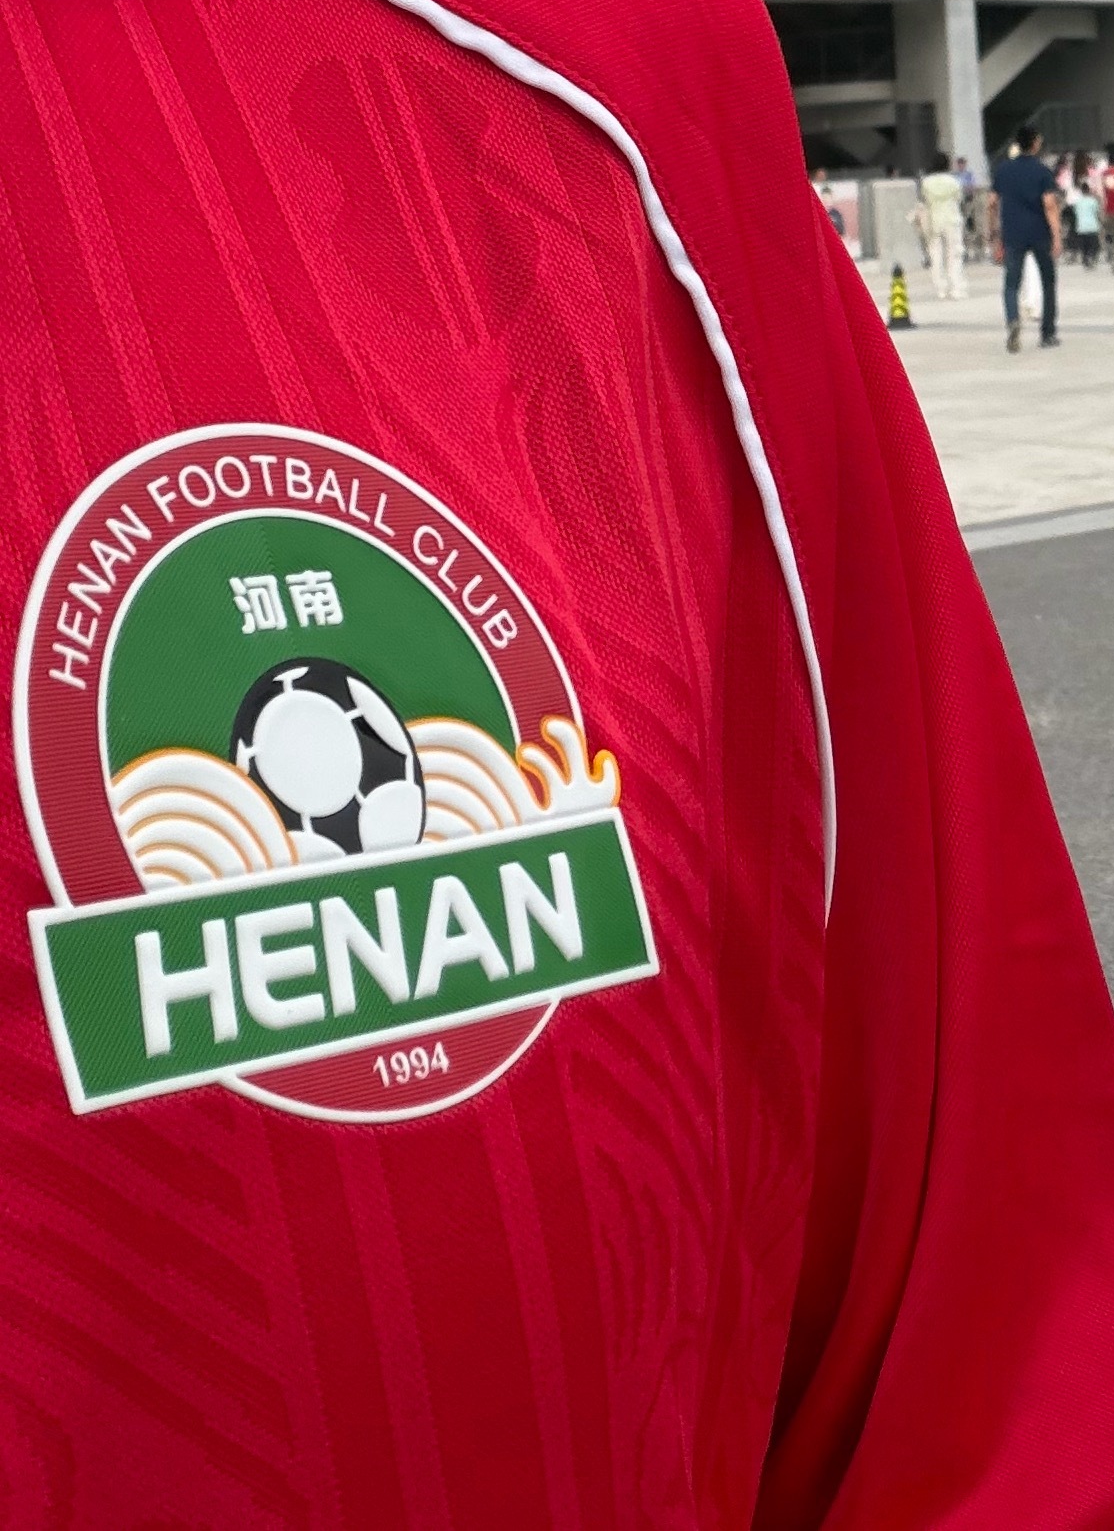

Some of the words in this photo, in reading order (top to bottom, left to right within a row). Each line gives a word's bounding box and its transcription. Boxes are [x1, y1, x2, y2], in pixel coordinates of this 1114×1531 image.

[49, 503, 153, 688] HENAN
[147, 456, 396, 538] FOOTBALL
[411, 524, 519, 650] CLUB
[230, 569, 344, 634] 河南
[135, 852, 583, 1057] HENAN
[372, 1042, 450, 1088] 1994
